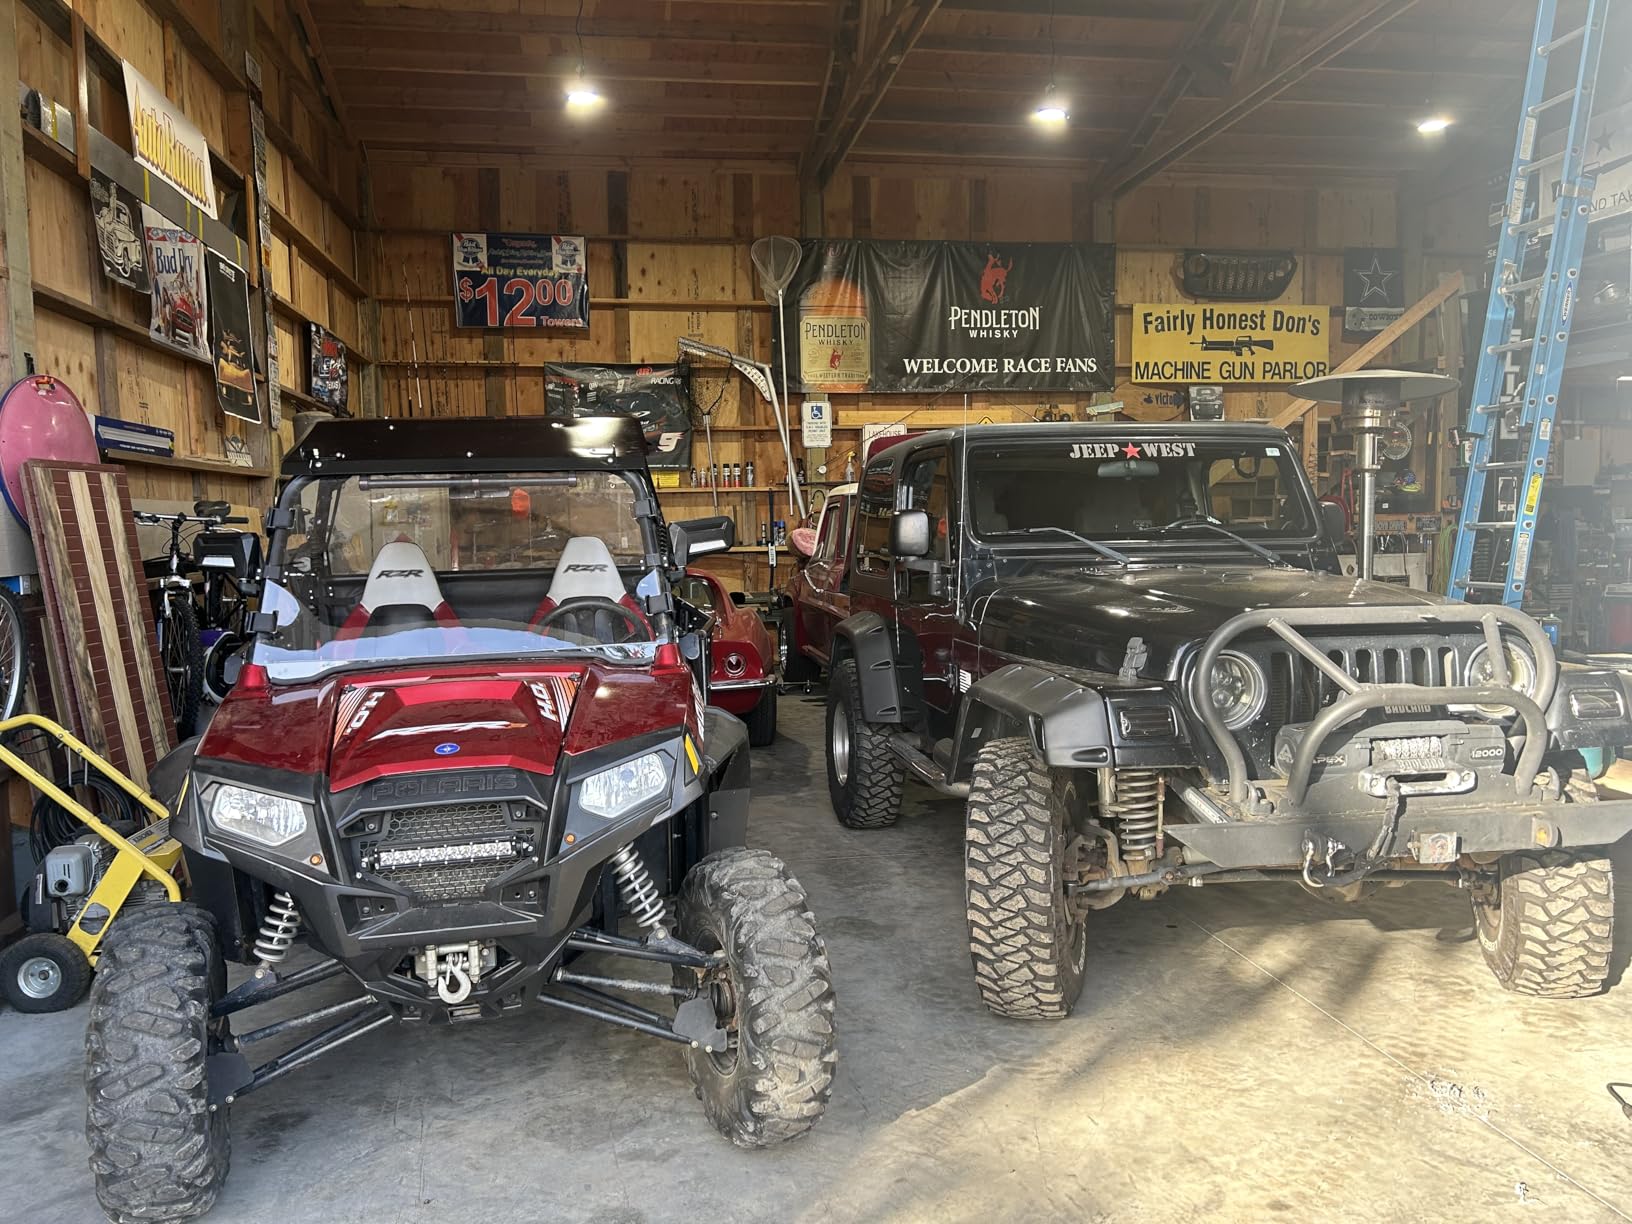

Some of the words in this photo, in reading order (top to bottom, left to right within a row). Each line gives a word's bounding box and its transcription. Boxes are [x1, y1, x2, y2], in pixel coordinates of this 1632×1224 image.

[156, 246, 177, 274] Bud
[178, 248, 193, 282] Dry
[496, 267, 513, 278] Day
[516, 267, 560, 278] Everyday
[540, 315, 584, 328] Towers
[948, 306, 1040, 330] PENDLETON
[1143, 309, 1196, 336] Fairly
[1202, 308, 1266, 331] Honest
[1272, 309, 1321, 336] Don's
[805, 322, 866, 340] PENDLETON
[968, 329, 1019, 338] WHISKY
[903, 358, 999, 374] WELCOME
[1003, 358, 1051, 373] RACE
[1055, 358, 1097, 373] FANS
[1135, 361, 1211, 380] MACHINE
[1219, 361, 1255, 380] GUN
[1262, 361, 1327, 380] PARLOR
[658, 432, 684, 452] 9
[1069, 443, 1120, 459] JEEP
[1141, 442, 1196, 457] WEST
[375, 569, 424, 580] RZR
[562, 563, 609, 574] RZR
[1471, 748, 1504, 759] 12000
[371, 774, 518, 800] POLARIS
